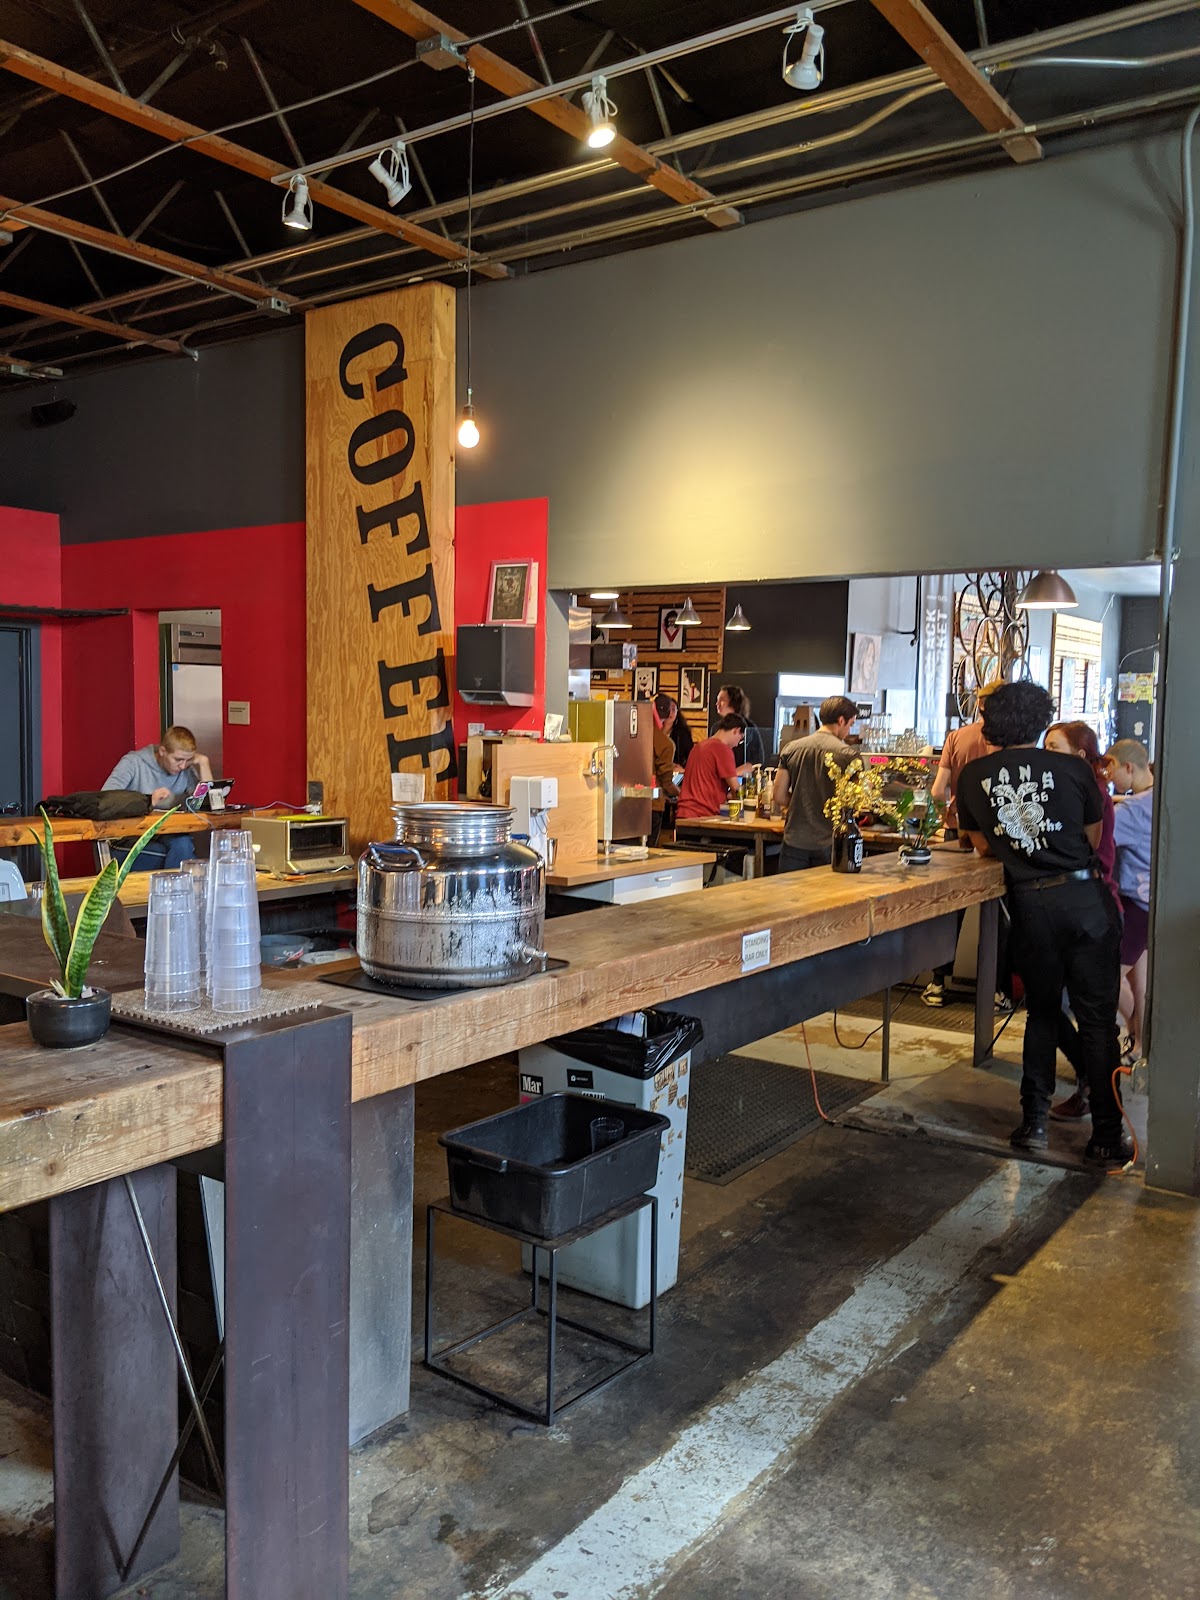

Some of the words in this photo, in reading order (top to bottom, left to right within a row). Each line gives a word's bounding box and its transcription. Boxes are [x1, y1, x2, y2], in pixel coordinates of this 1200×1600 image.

[339, 322, 458, 783] COFFEE
[981, 764, 1055, 796] VANS
[1038, 818, 1063, 832] the
[756, 949, 768, 959] ONLY
[522, 1076, 541, 1094] Mar
